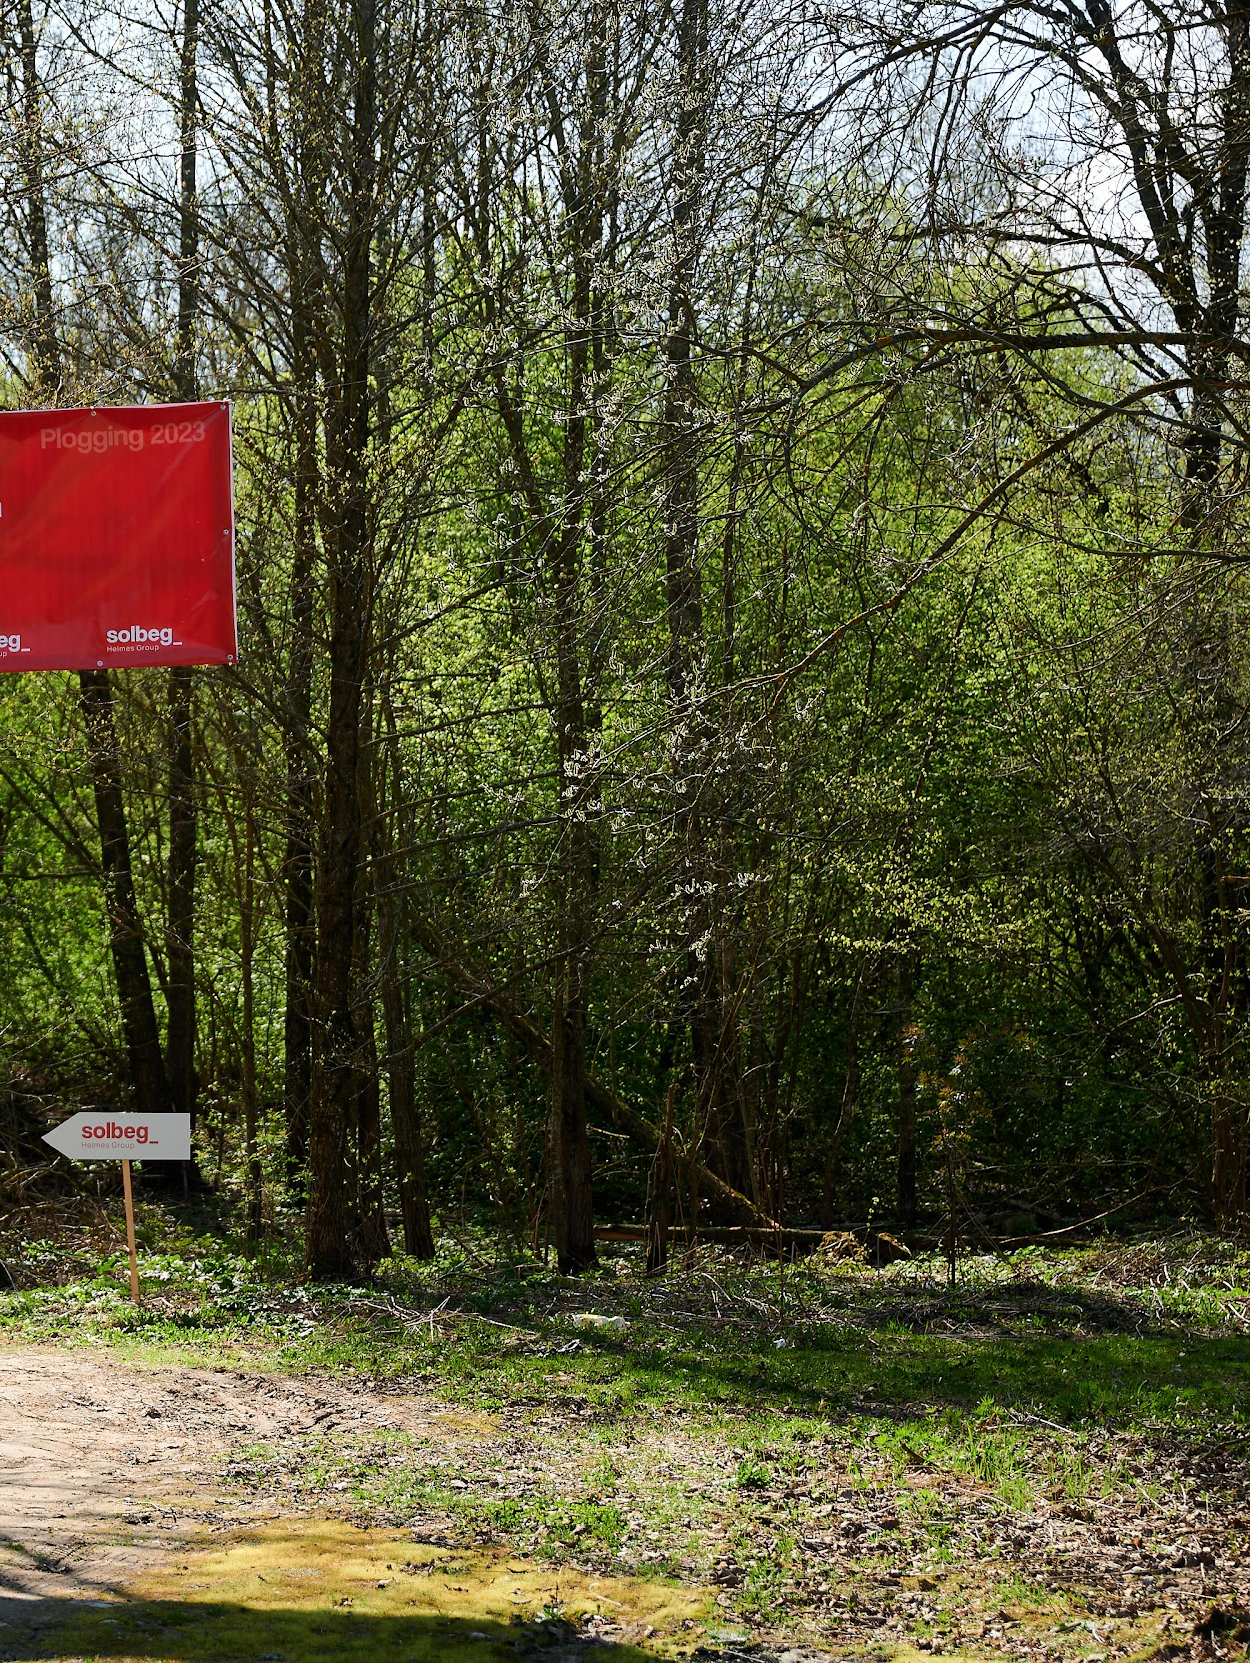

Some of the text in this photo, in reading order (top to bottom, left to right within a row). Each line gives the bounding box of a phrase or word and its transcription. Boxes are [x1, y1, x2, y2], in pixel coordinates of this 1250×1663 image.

[40, 420, 206, 454] Plogging 2023
[136, 644, 159, 652] Group
[111, 1142, 135, 1150] Group
